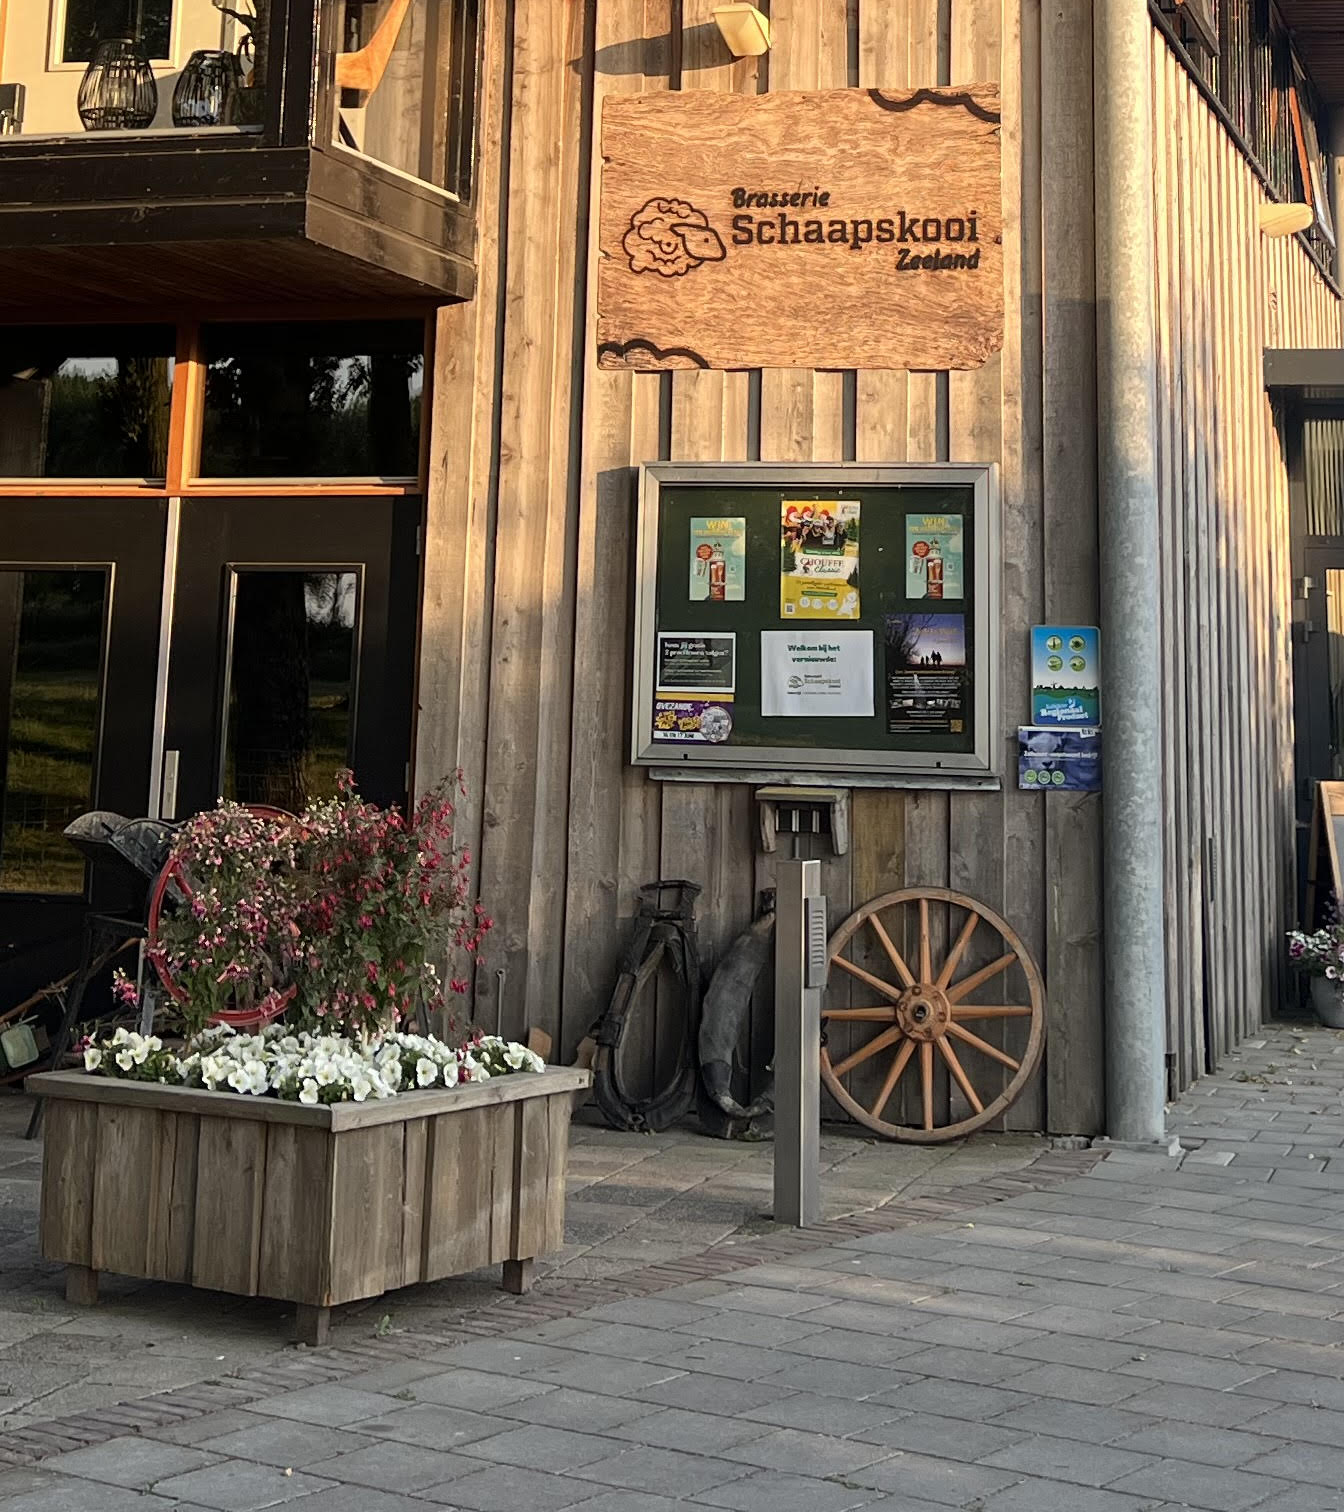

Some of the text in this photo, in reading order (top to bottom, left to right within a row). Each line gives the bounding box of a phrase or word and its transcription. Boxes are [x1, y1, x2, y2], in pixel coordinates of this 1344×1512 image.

[731, 185, 831, 209] Brasserie
[732, 210, 980, 251] Schaapskooi
[895, 247, 982, 271] Zeeland
[800, 557, 844, 567] CHOUFFE
[787, 644, 818, 652] Welkom
